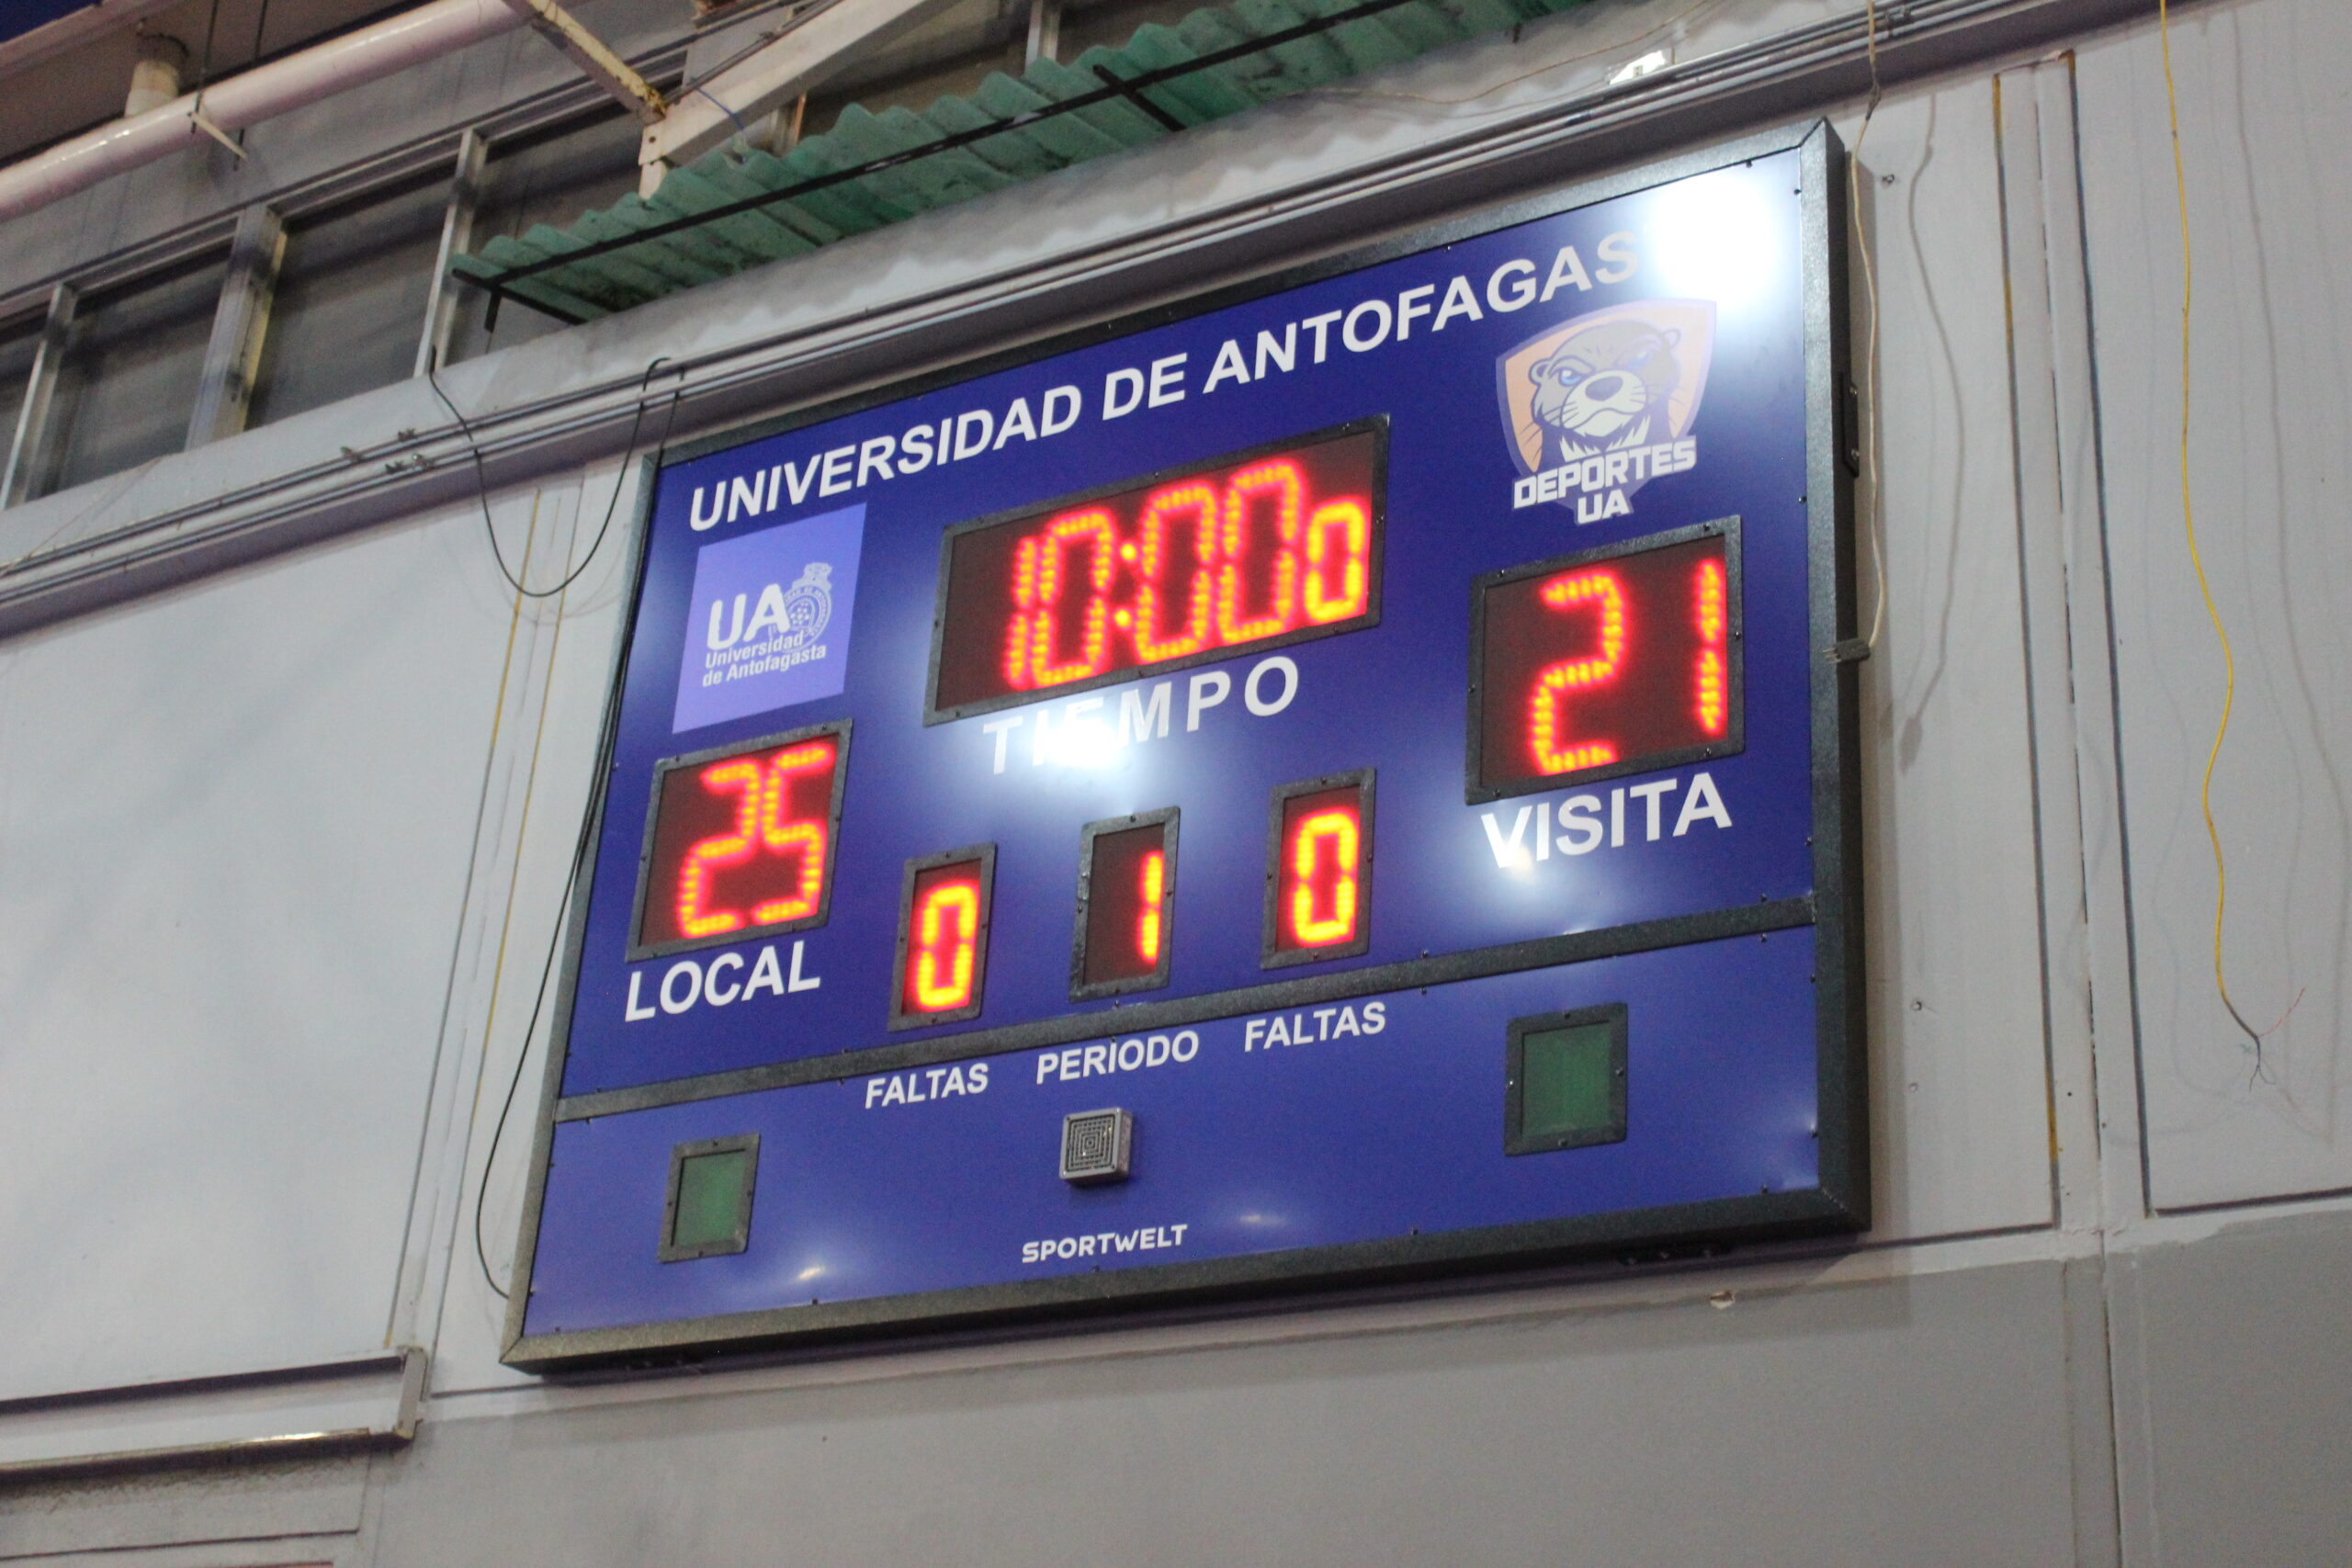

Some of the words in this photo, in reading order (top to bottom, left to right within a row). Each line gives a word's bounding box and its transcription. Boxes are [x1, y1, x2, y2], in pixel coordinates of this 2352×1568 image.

[689, 385, 1082, 531] UNIVERSIDAD
[1102, 353, 1188, 421] DE
[1203, 230, 1646, 395] ANTOFAGAS
[1513, 439, 1697, 509] DEPORTES
[1577, 488, 1630, 525] UA
[705, 629, 805, 670] Universidad
[707, 583, 791, 650] UA
[702, 669, 723, 687] de
[726, 644, 827, 682] Antofagasta
[1532, 558, 1728, 774] 21
[678, 742, 835, 938] 25
[1480, 772, 1733, 868] VISITA
[1139, 851, 1165, 963] 1
[1294, 810, 1358, 946] 0
[625, 941, 821, 1022] LOCAL
[916, 884, 978, 1010] 0
[1036, 1030, 1200, 1085] PERIODO
[1244, 1001, 1387, 1052] FALTAS
[865, 1063, 989, 1109] FALTAS
[1022, 1224, 1188, 1264] SPORTWELT
